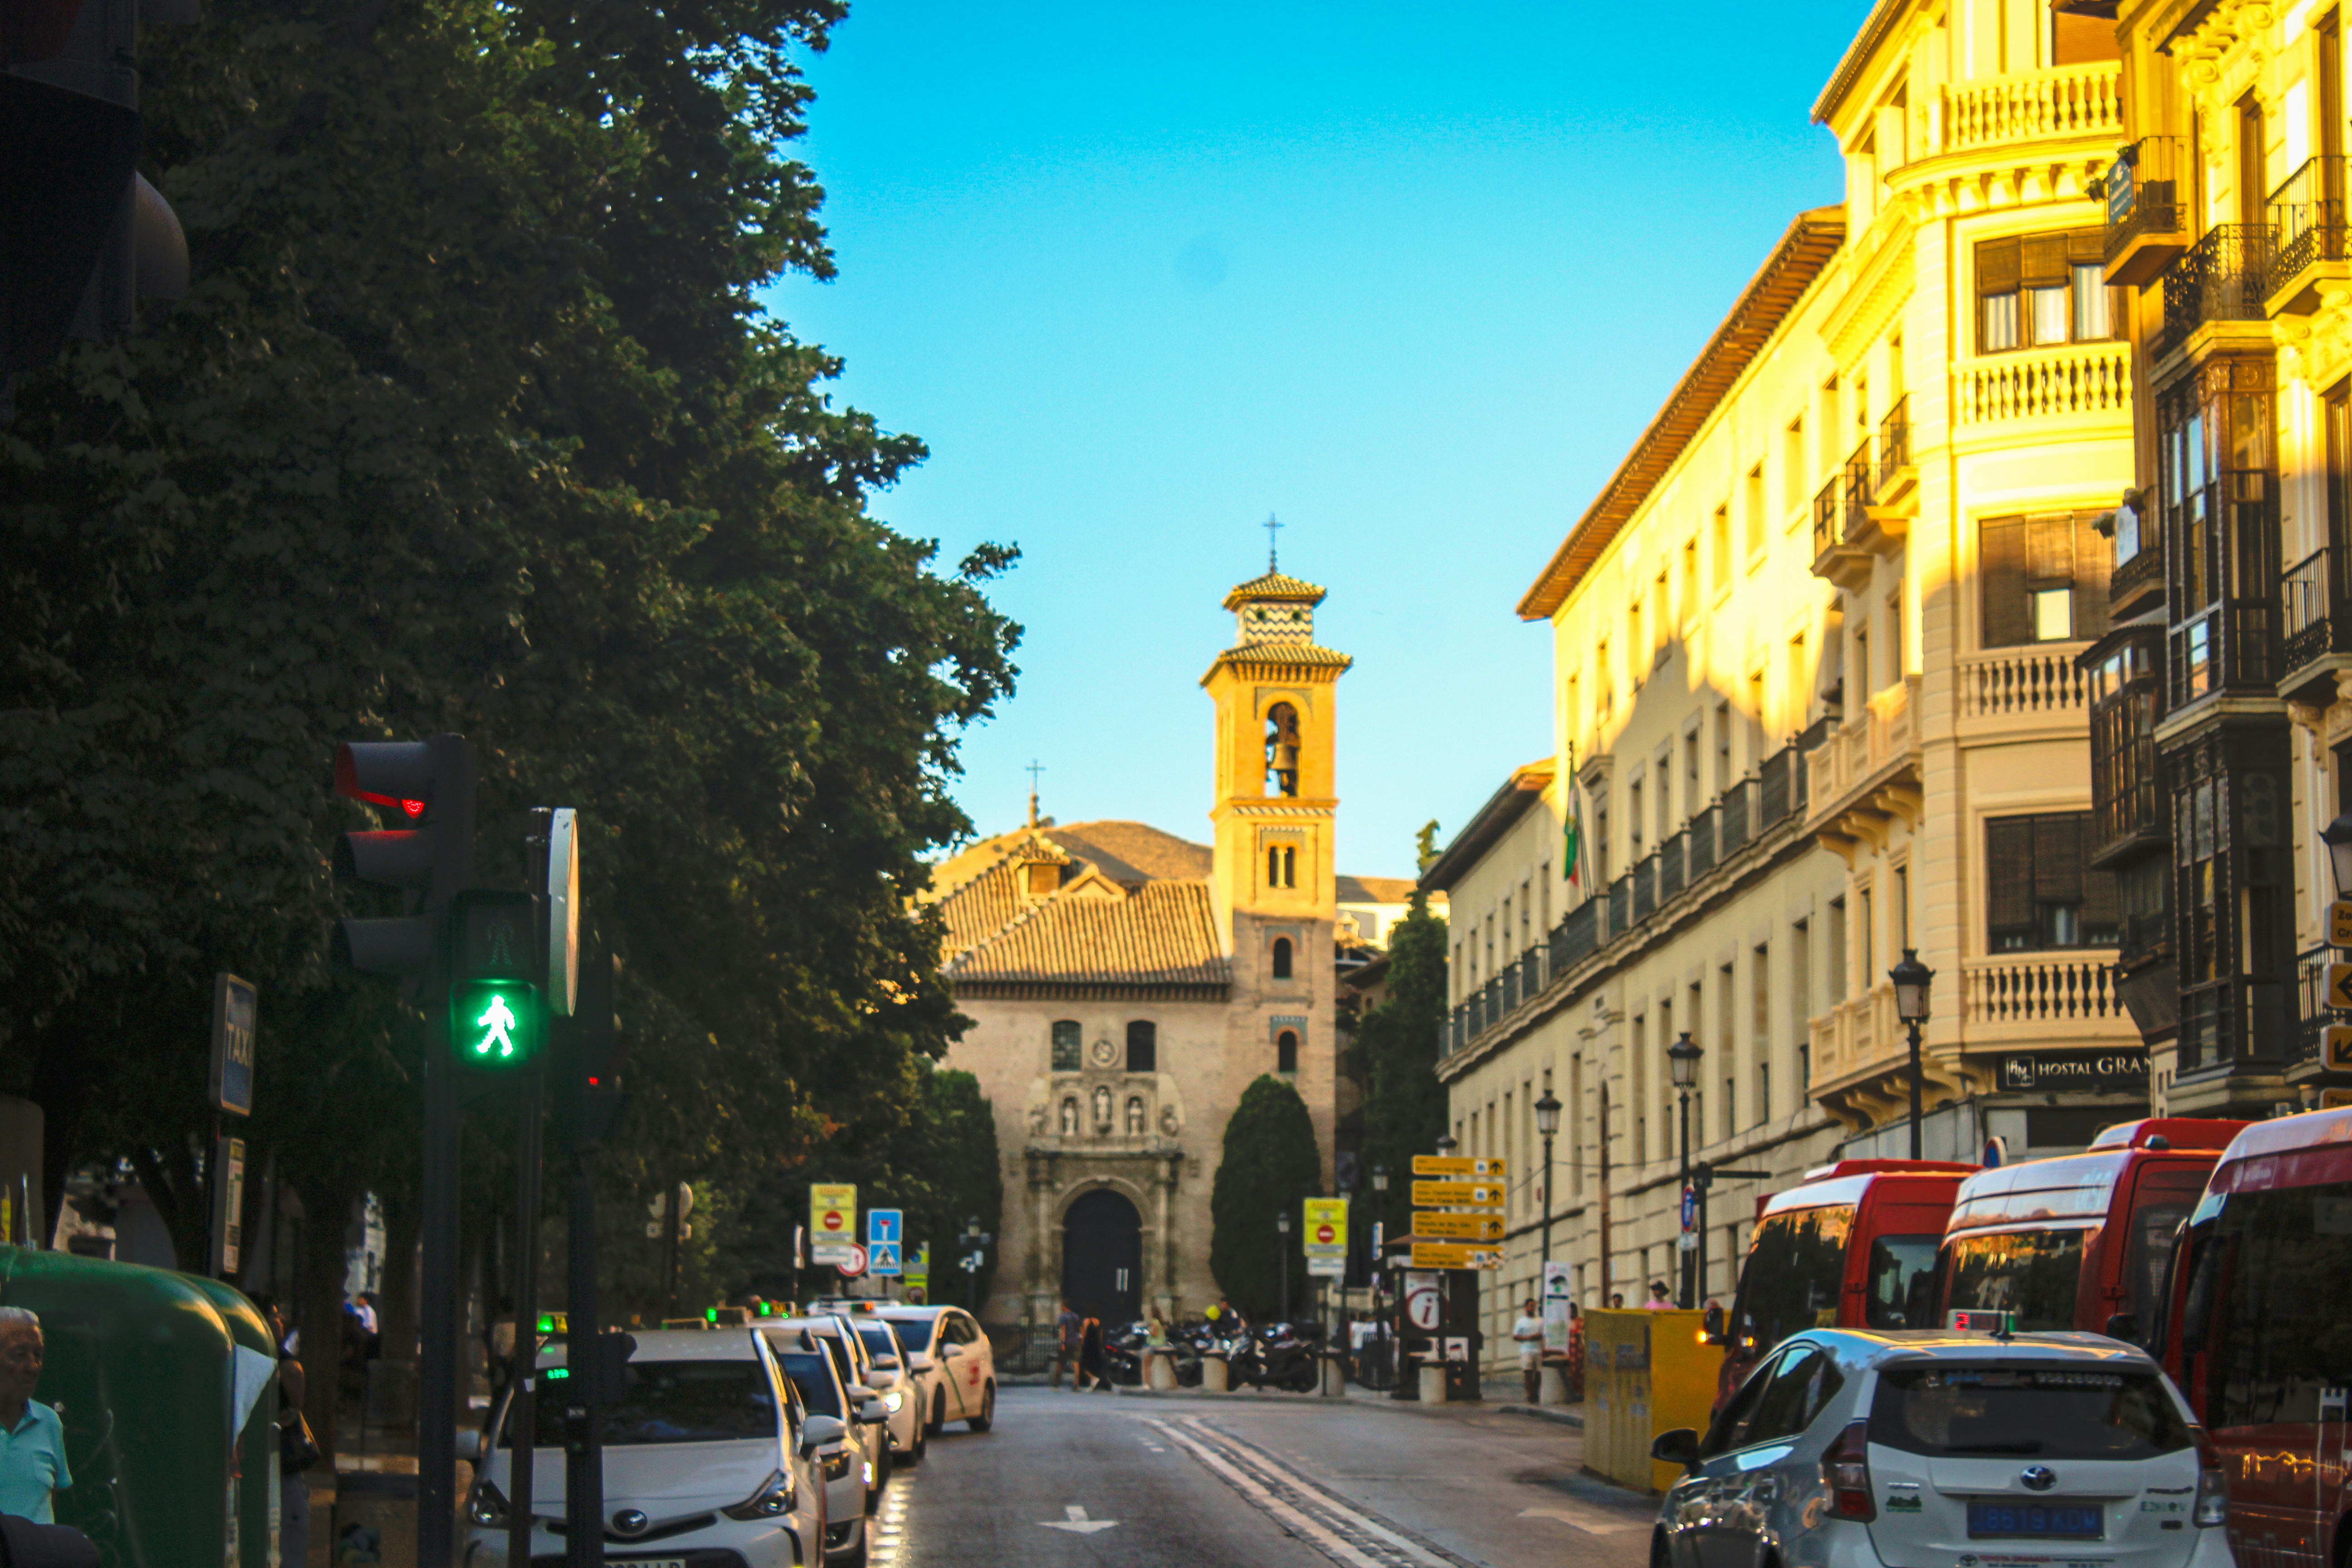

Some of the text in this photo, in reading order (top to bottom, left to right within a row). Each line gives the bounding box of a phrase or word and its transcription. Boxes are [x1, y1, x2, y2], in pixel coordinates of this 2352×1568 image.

[2338, 910, 2352, 920] Zo
[2337, 927, 2352, 937] Cr
[227, 1022, 253, 1067] TAXI
[2039, 1062, 2092, 1076] HOSTAL
[1955, 1313, 1970, 1331] 2
